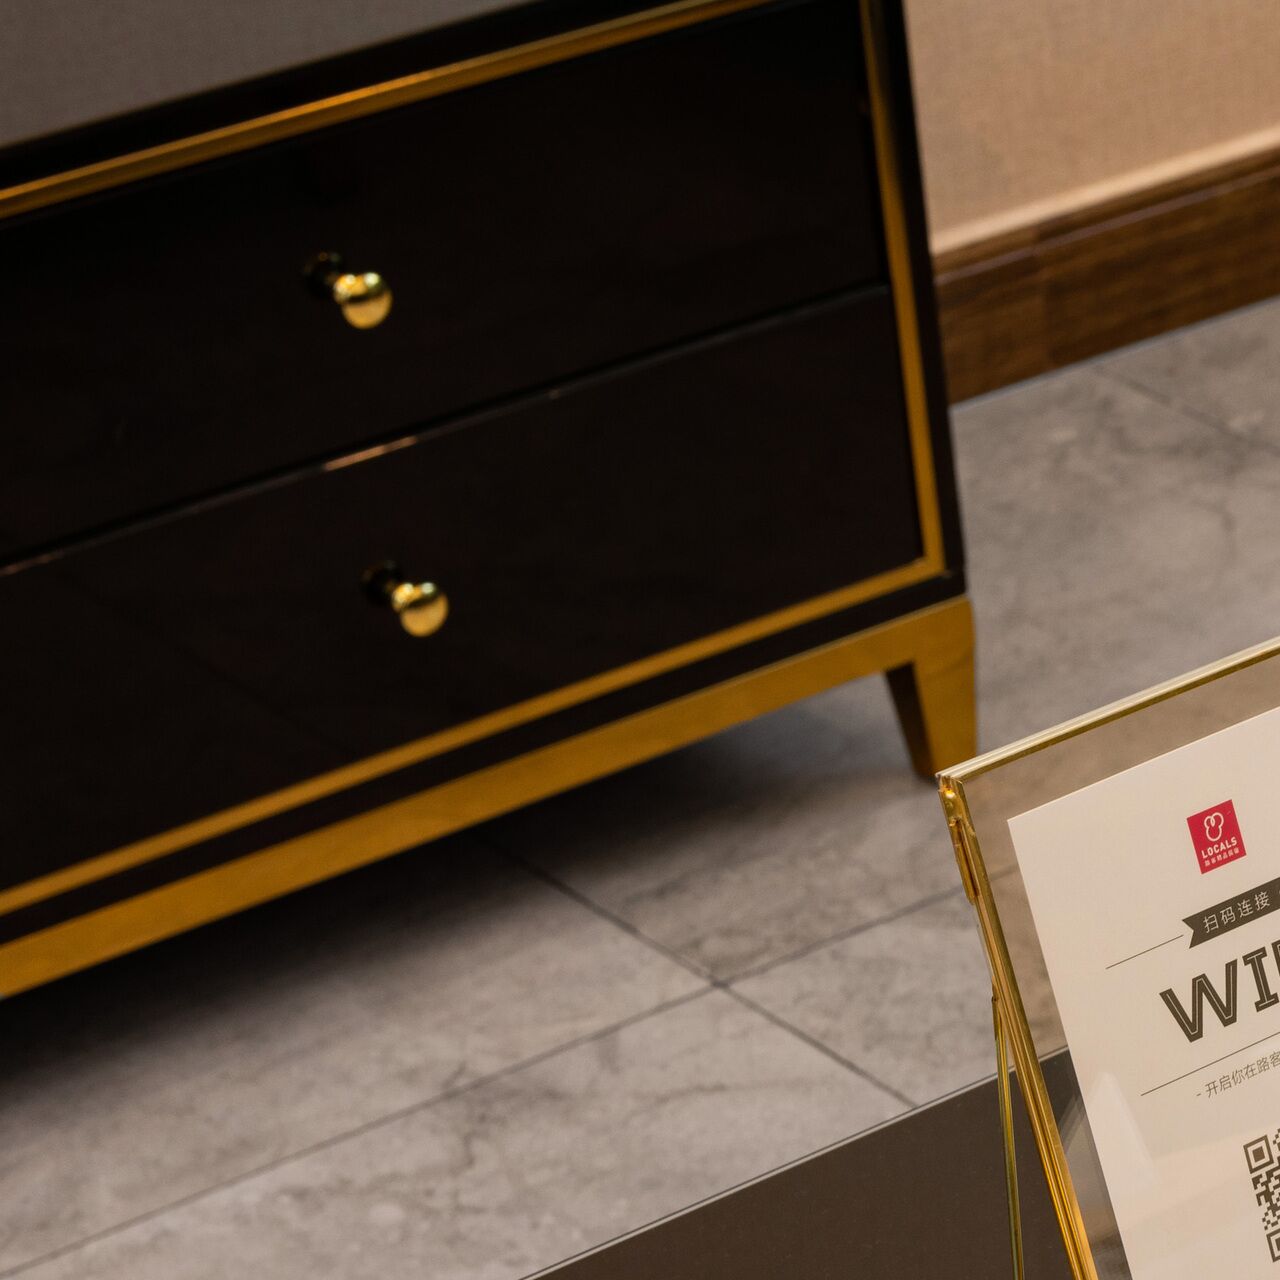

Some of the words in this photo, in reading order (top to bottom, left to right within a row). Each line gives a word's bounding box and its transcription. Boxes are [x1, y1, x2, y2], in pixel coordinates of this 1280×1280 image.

[1201, 836, 1238, 859] LOCALS
[1203, 891, 1270, 933] 扫码连接
